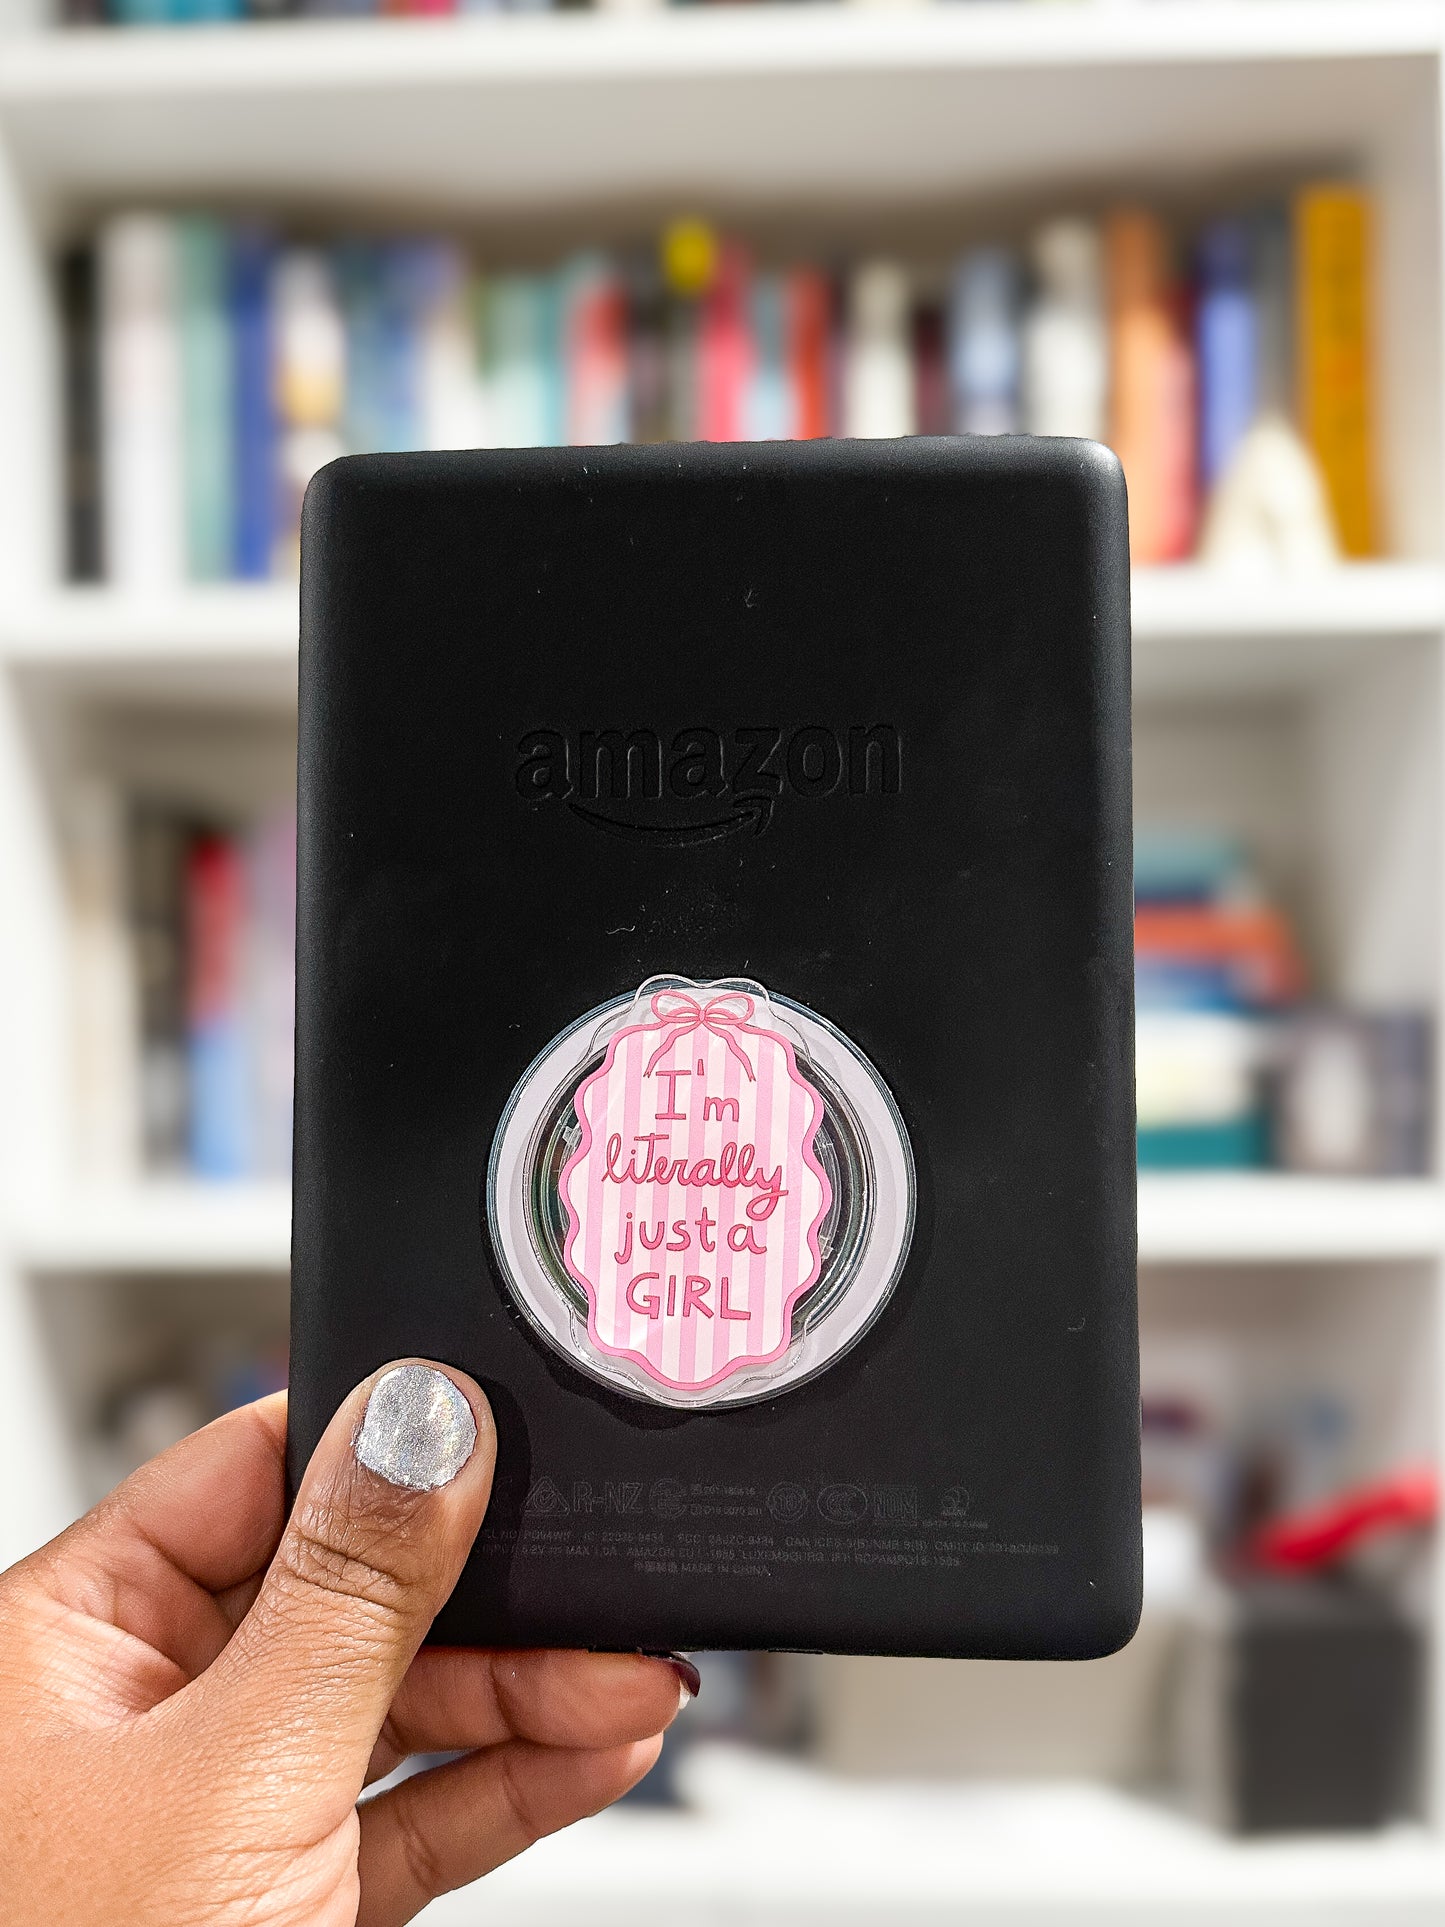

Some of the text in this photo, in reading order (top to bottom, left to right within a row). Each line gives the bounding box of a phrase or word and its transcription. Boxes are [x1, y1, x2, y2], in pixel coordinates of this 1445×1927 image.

[515, 723, 903, 800] amazon
[654, 1058, 740, 1123] I'm
[601, 1132, 789, 1222] literally
[614, 1206, 768, 1265] just a
[625, 1271, 752, 1321] GIRL
[572, 1480, 644, 1514] R-NZ
